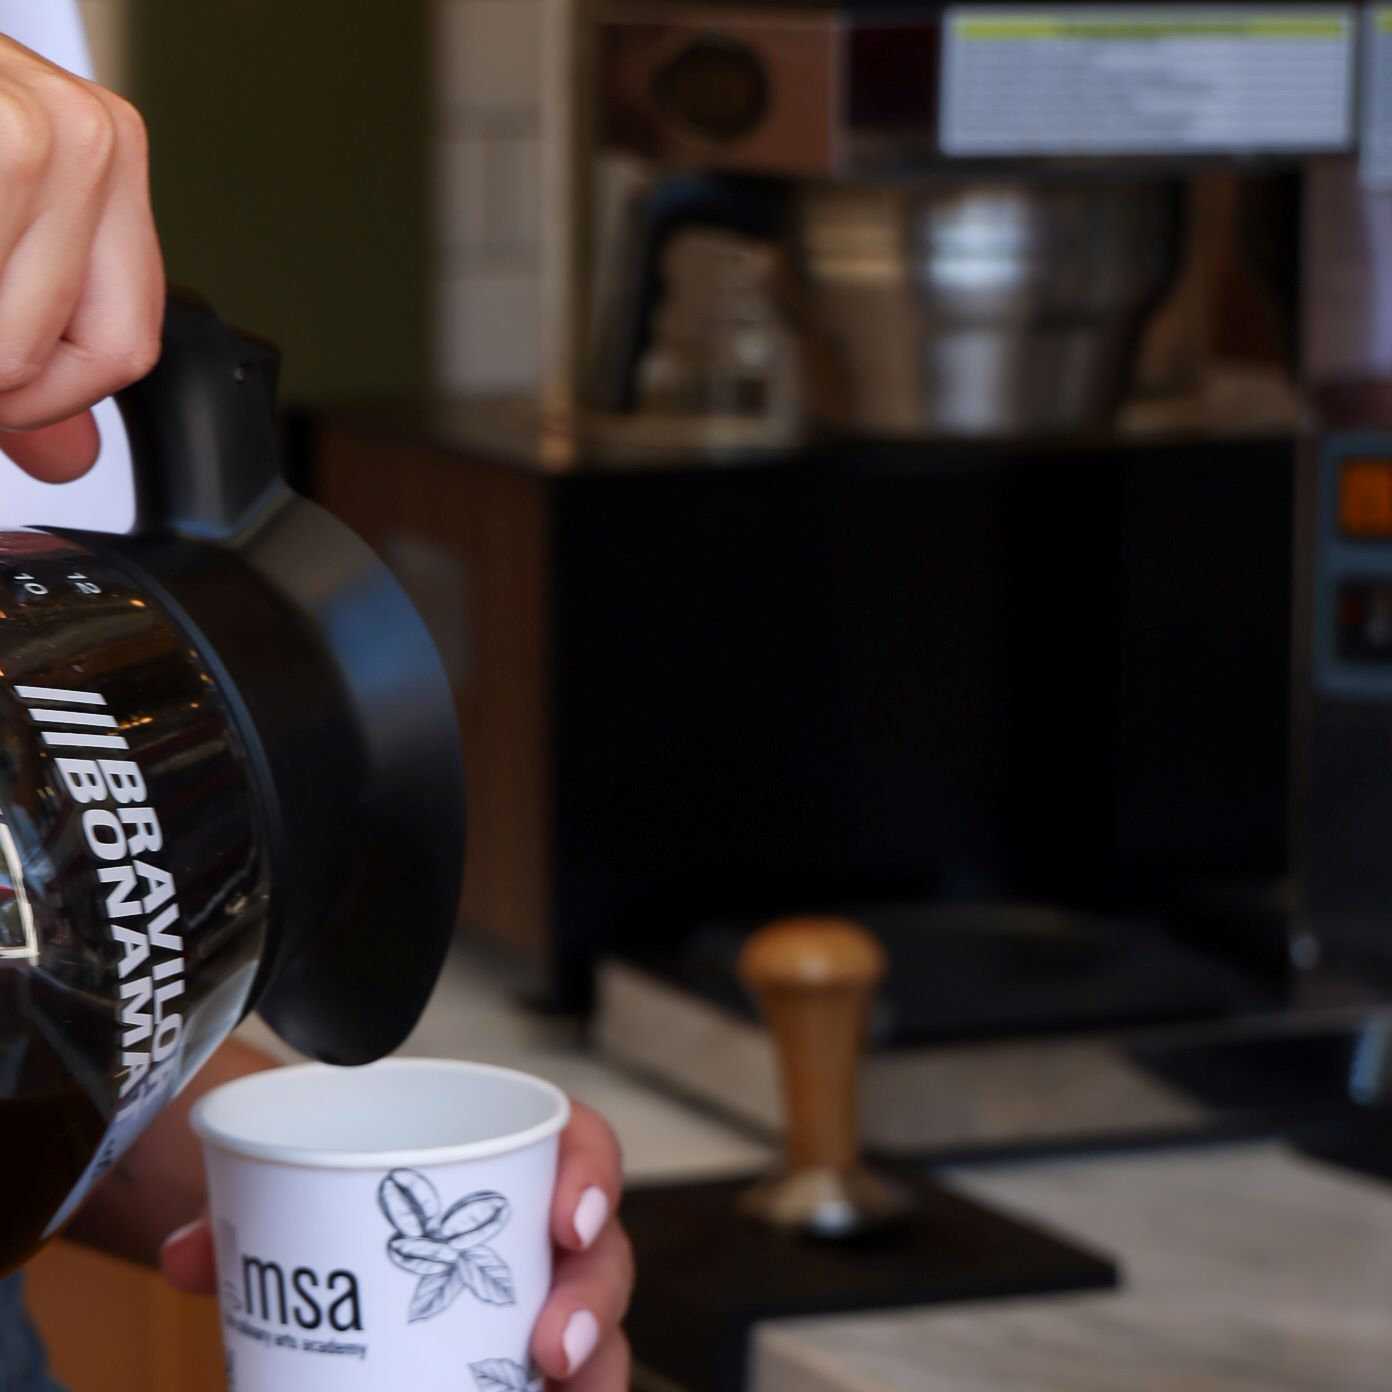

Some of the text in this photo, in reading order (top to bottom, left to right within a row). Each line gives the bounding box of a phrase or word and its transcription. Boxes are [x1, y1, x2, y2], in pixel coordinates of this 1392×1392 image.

[14, 572, 48, 595] 10
[68, 572, 102, 595] 12
[241, 1253, 364, 1331] msa
